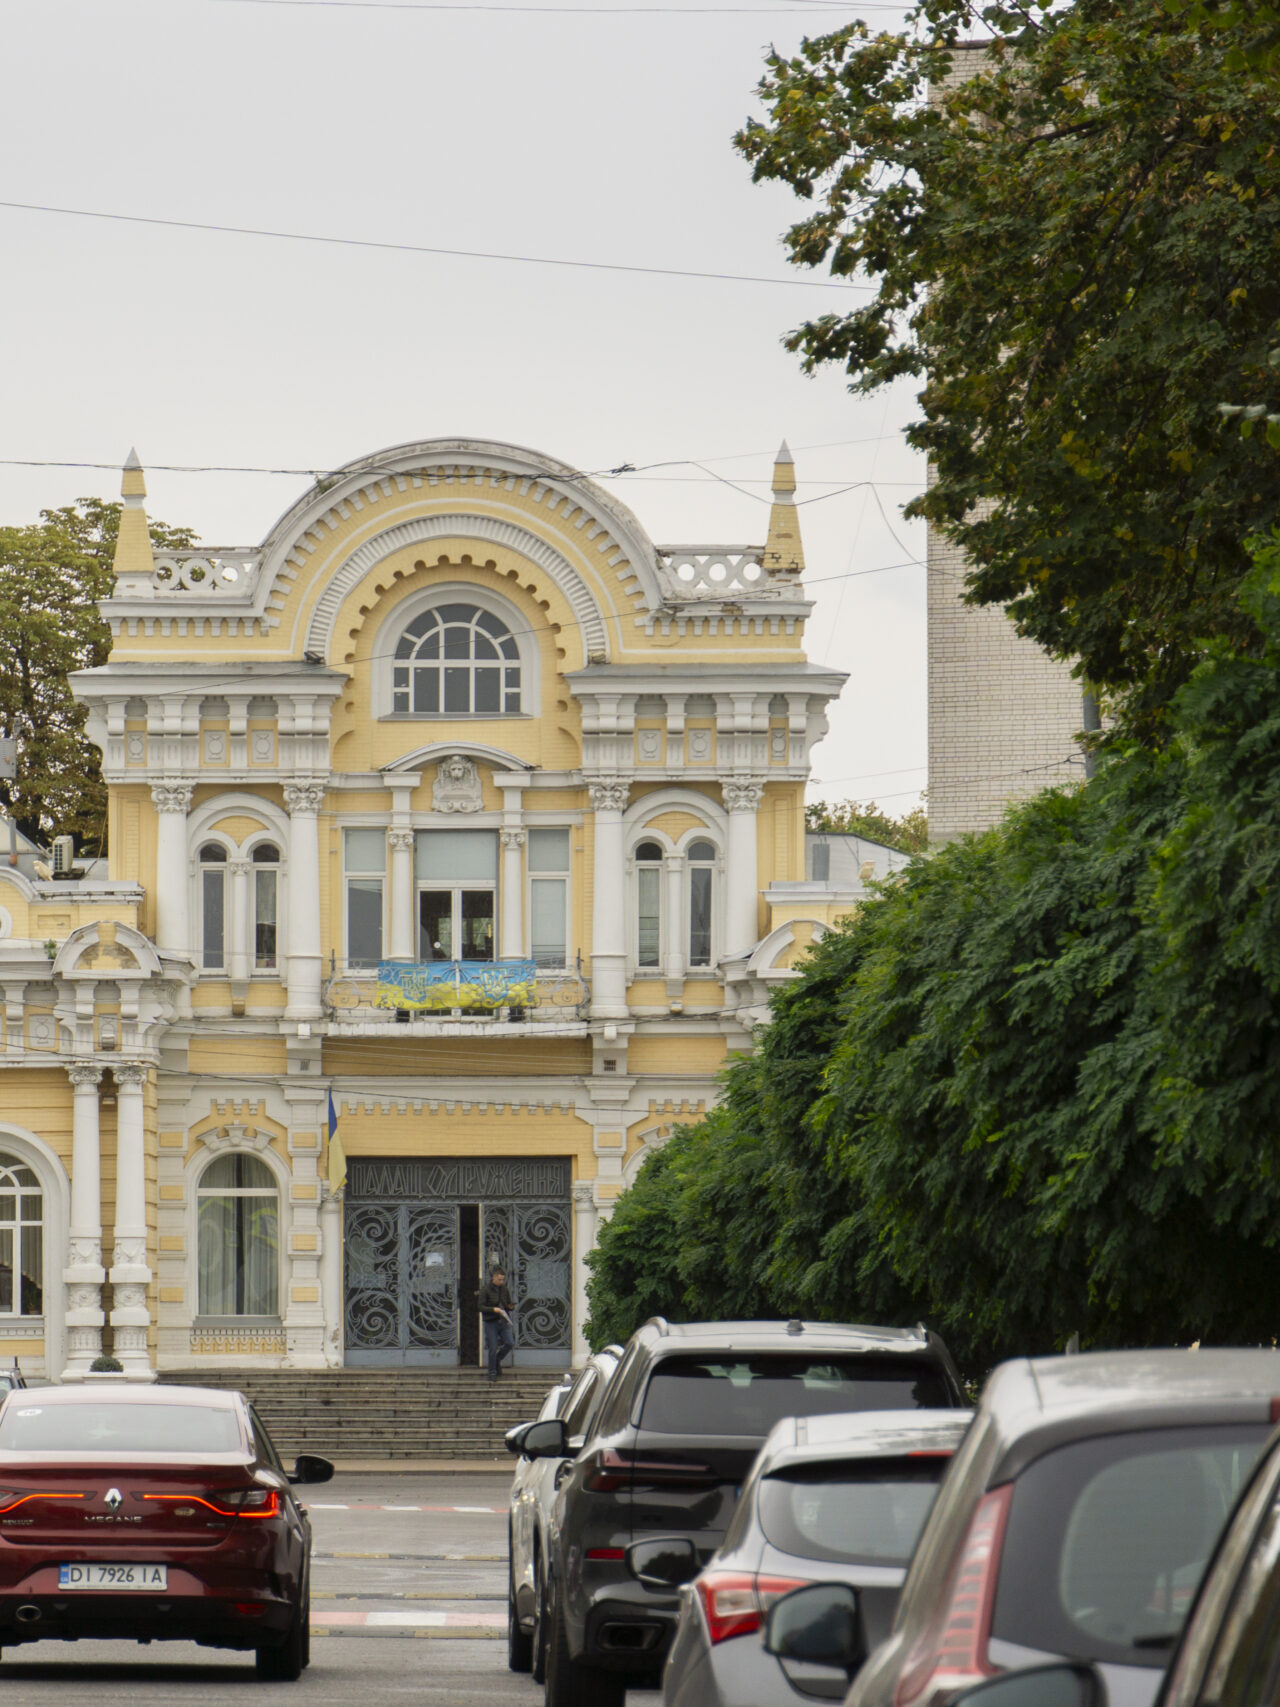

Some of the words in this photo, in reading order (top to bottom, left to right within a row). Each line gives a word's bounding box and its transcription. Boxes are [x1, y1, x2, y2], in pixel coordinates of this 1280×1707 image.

[352, 1164, 423, 1199] ПАЛАЦ
[426, 1164, 564, 1199] ОДРУЖЕННЯ
[70, 1567, 91, 1583] DI
[98, 1567, 135, 1583] 7926
[142, 1567, 162, 1583] IA
